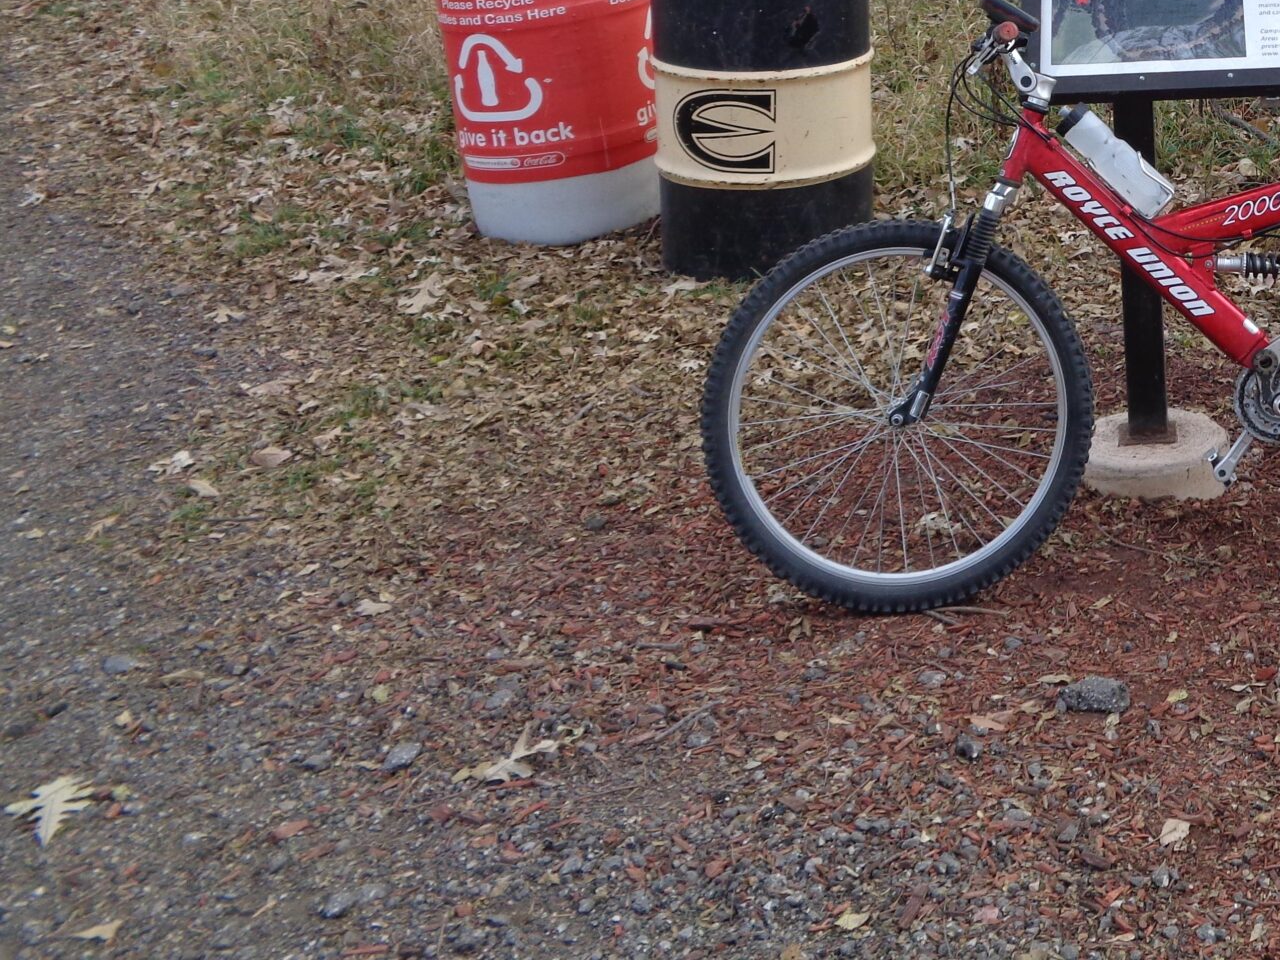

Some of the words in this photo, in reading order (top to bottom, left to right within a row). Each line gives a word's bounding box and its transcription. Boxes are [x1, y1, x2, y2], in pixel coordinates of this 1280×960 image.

[459, 15, 482, 26] and
[484, 13, 523, 25] Cans
[527, 6, 567, 21] Here
[459, 127, 487, 148] give
[491, 128, 507, 147] it
[513, 121, 575, 146] back
[1043, 170, 1135, 240] ROYCE
[1126, 247, 1216, 317] UNION
